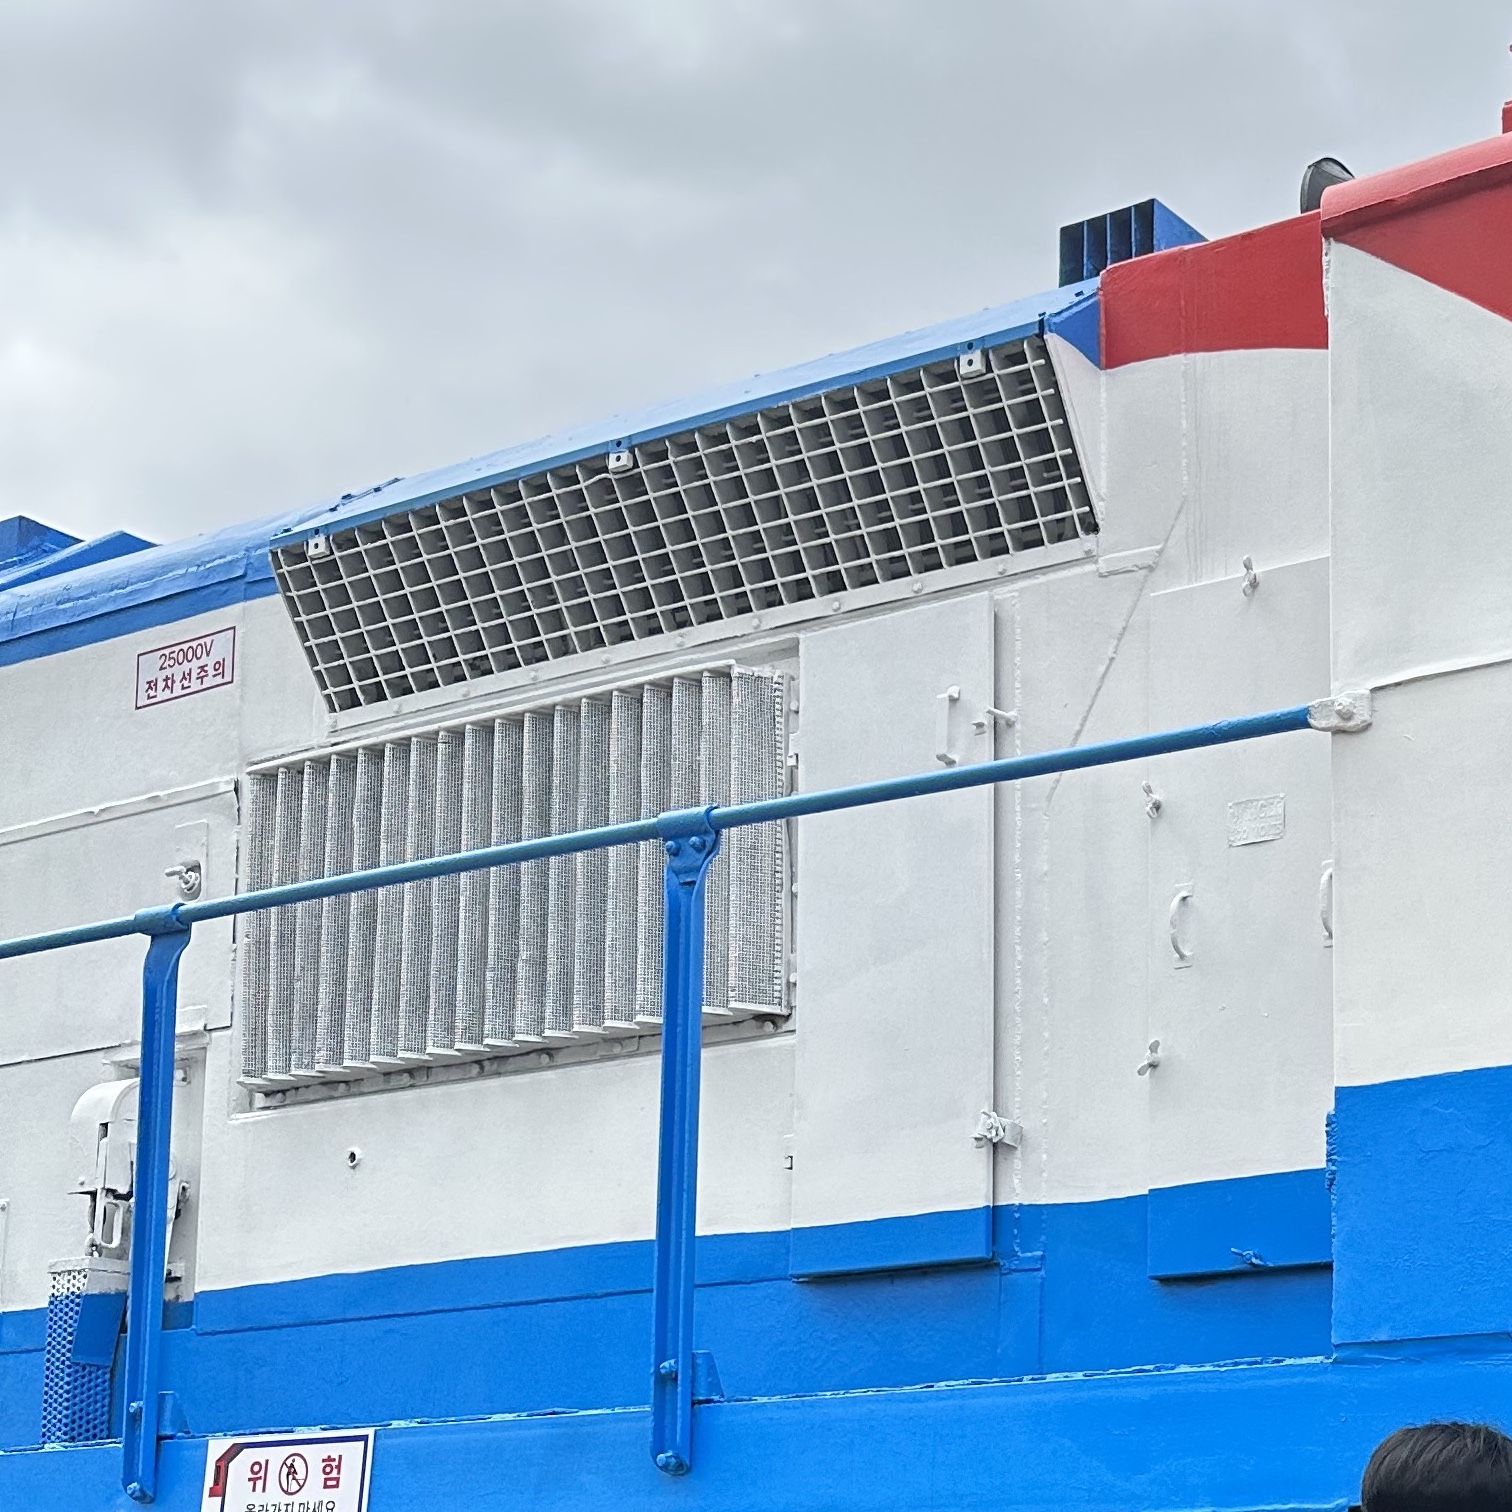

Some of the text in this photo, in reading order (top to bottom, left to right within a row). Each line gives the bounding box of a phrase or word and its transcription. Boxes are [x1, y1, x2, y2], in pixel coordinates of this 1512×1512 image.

[159, 639, 214, 671] 25000V
[145, 657, 226, 700] 전차선주의
[248, 1455, 343, 1493] 위 험
